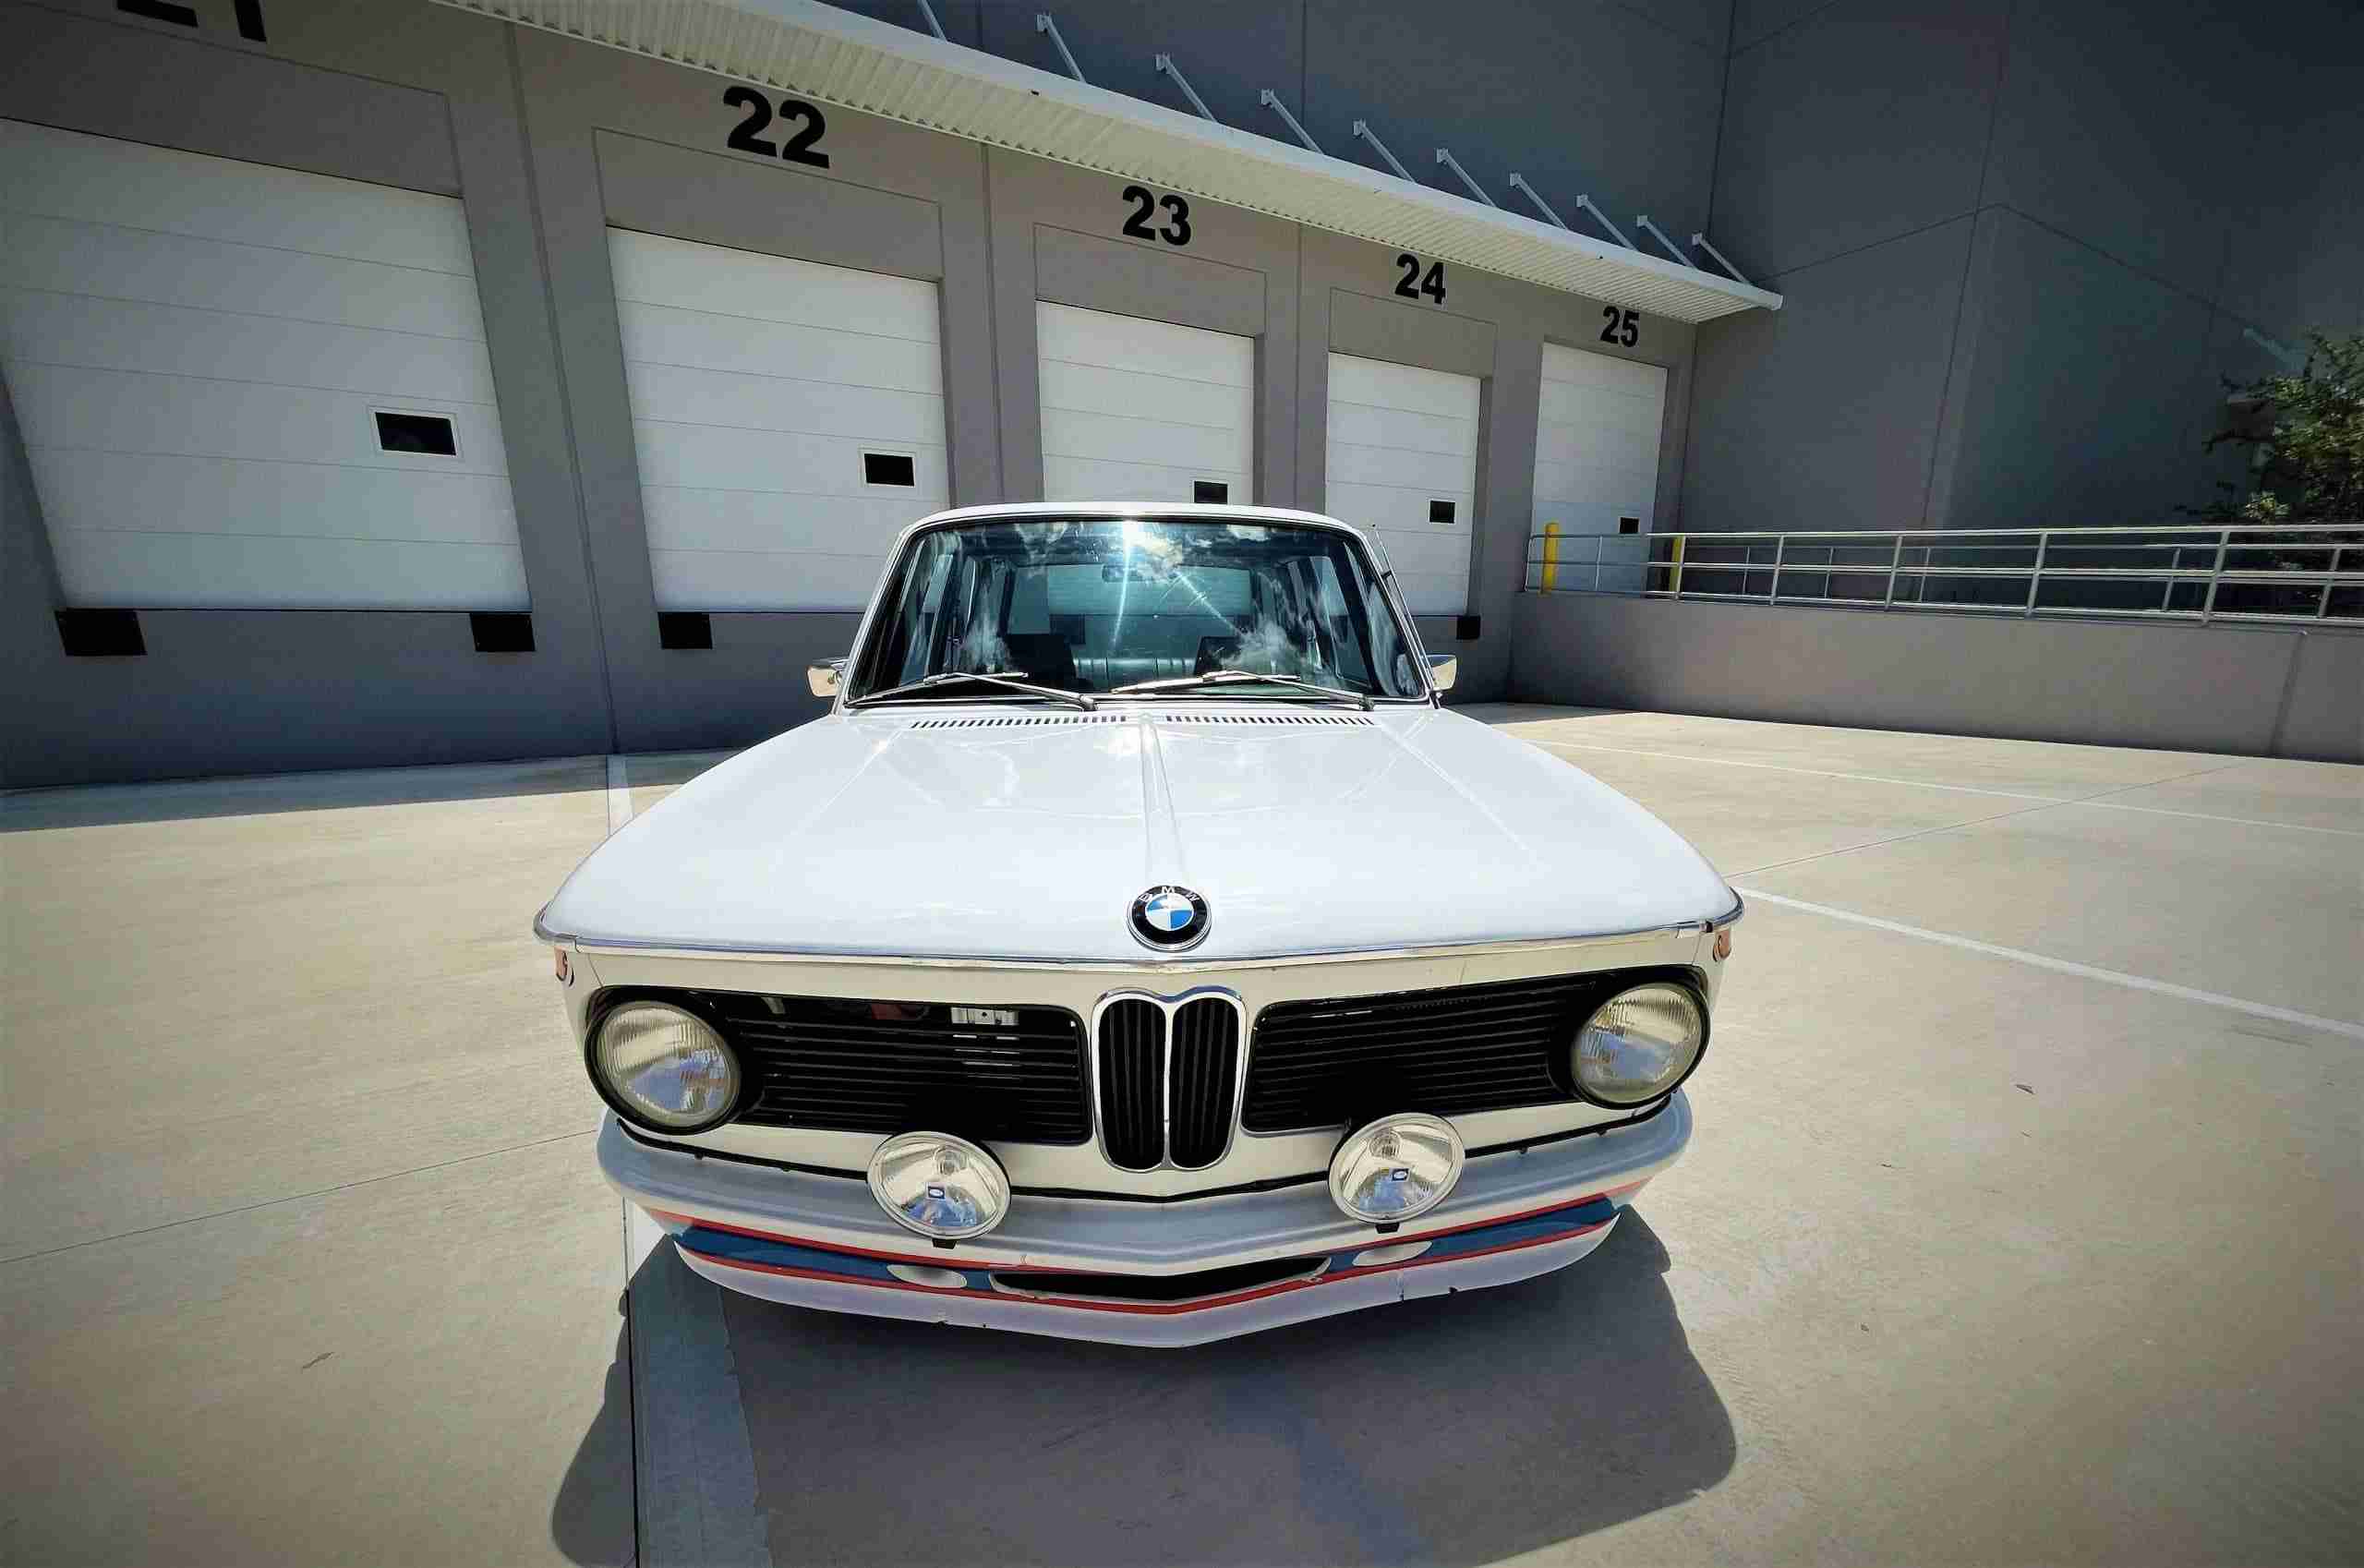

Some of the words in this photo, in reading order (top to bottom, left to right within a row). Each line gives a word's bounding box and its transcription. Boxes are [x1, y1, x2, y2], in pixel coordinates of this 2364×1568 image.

[722, 86, 830, 169] 22
[1122, 185, 1192, 247] 23
[1394, 253, 1447, 305] 24
[1599, 306, 1640, 348] 25
[1136, 886, 1201, 903] BMW
